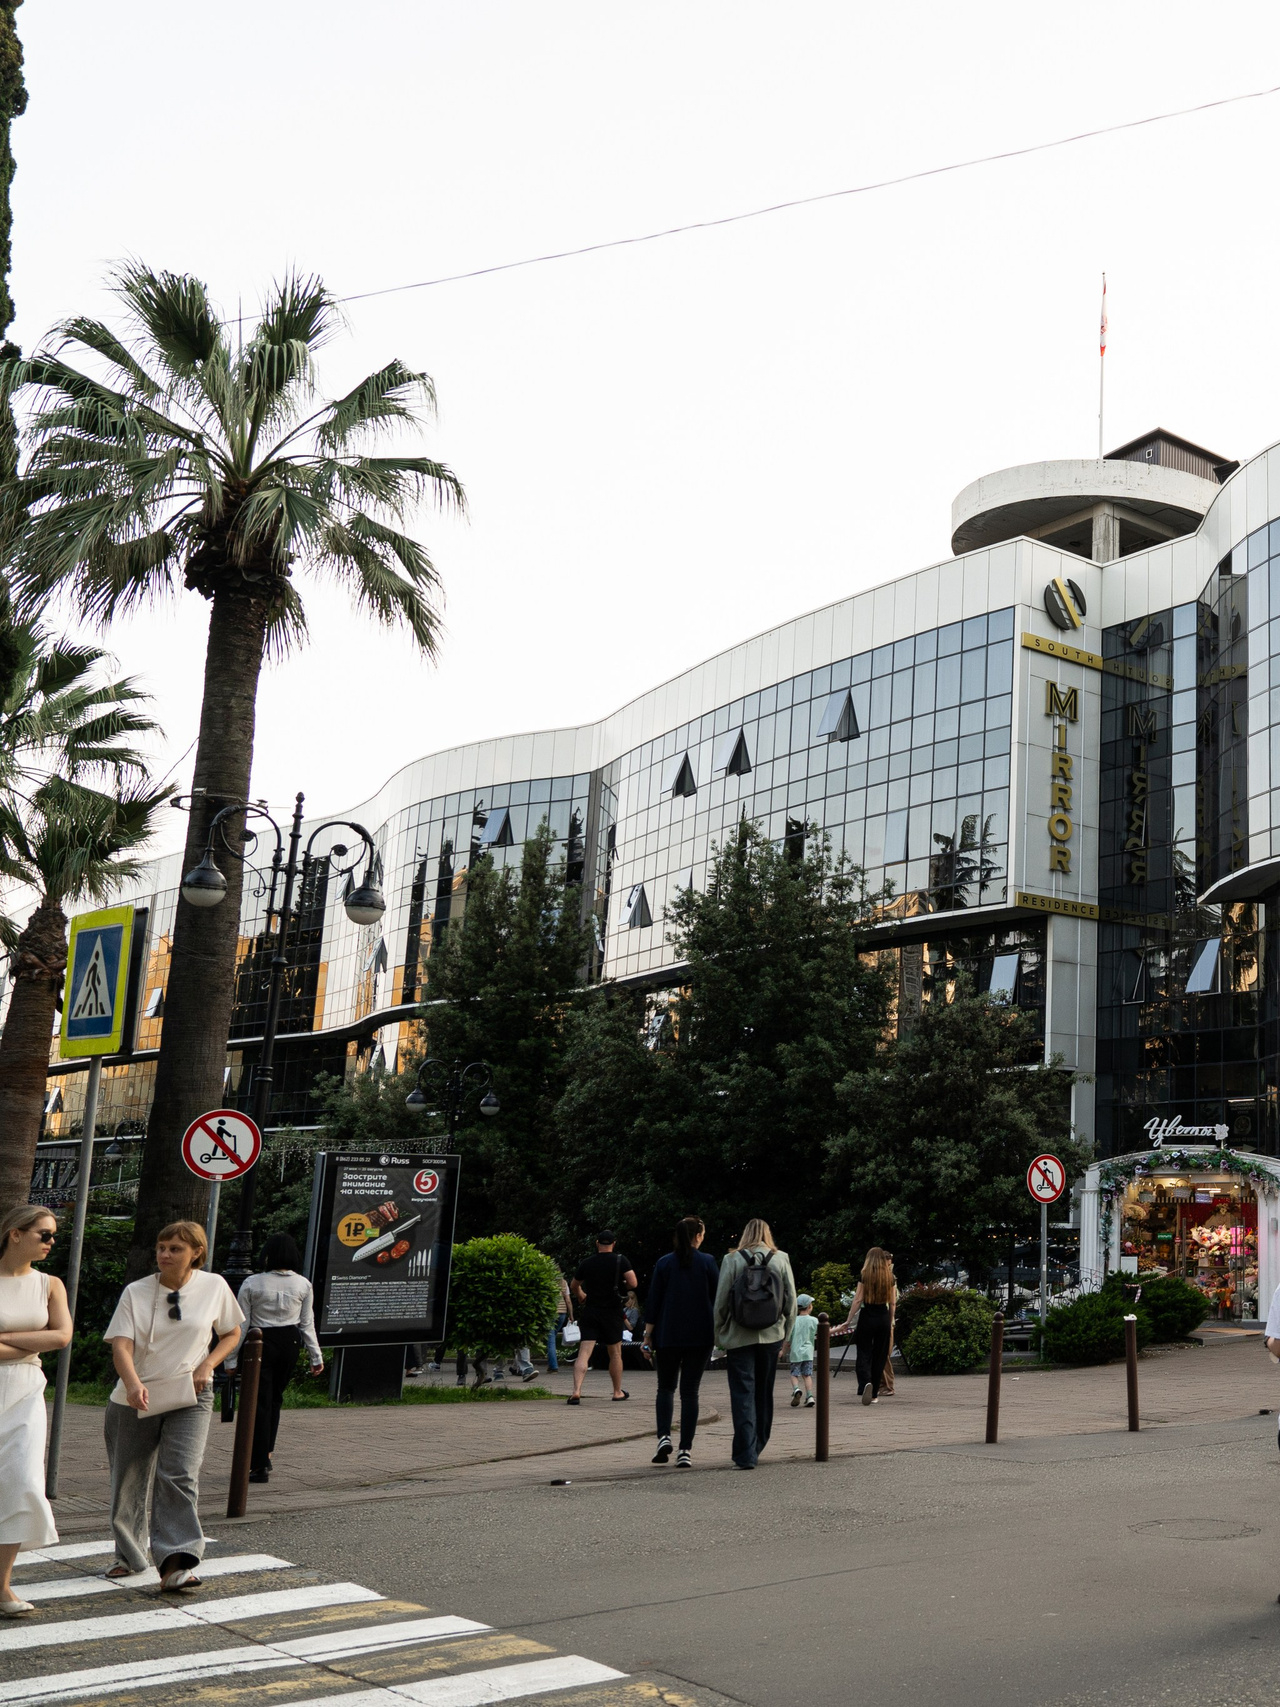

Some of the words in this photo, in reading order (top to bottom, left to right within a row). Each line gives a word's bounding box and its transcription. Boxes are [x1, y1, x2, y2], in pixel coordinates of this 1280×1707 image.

[1035, 638, 1093, 664] SOUTH
[1044, 680, 1079, 873] MIRROR
[1022, 895, 1095, 916] RESIDENCE
[1143, 1114, 1213, 1147] Цветы
[391, 1156, 410, 1165] Russ
[343, 1172, 387, 1181] Заострите
